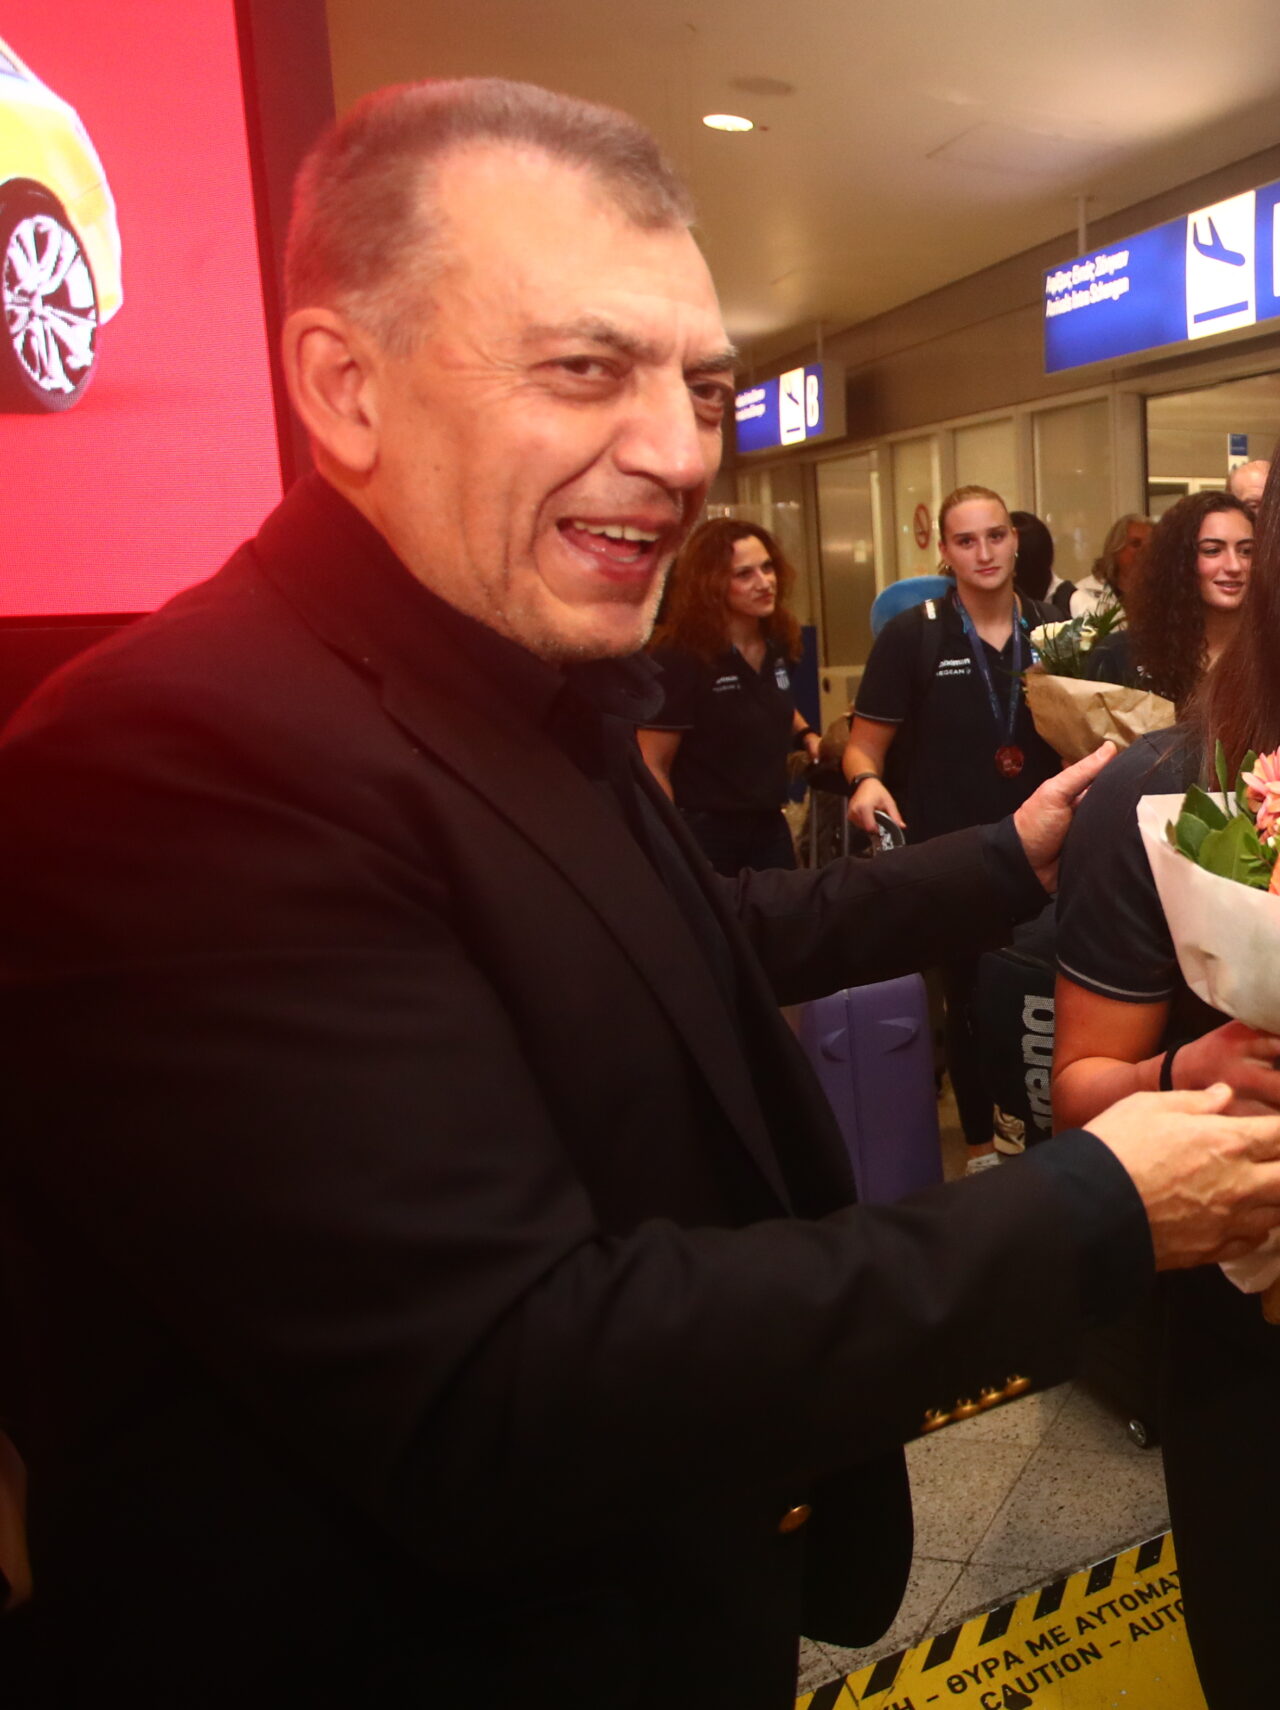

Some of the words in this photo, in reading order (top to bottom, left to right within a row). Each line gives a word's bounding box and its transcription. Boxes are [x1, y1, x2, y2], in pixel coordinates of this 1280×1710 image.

[806, 374, 820, 428] B
[946, 1650, 1024, 1695] ΘΥΡΑ
[1025, 1625, 1072, 1657] ΜΕ
[980, 1642, 1103, 1710] CAUTION
